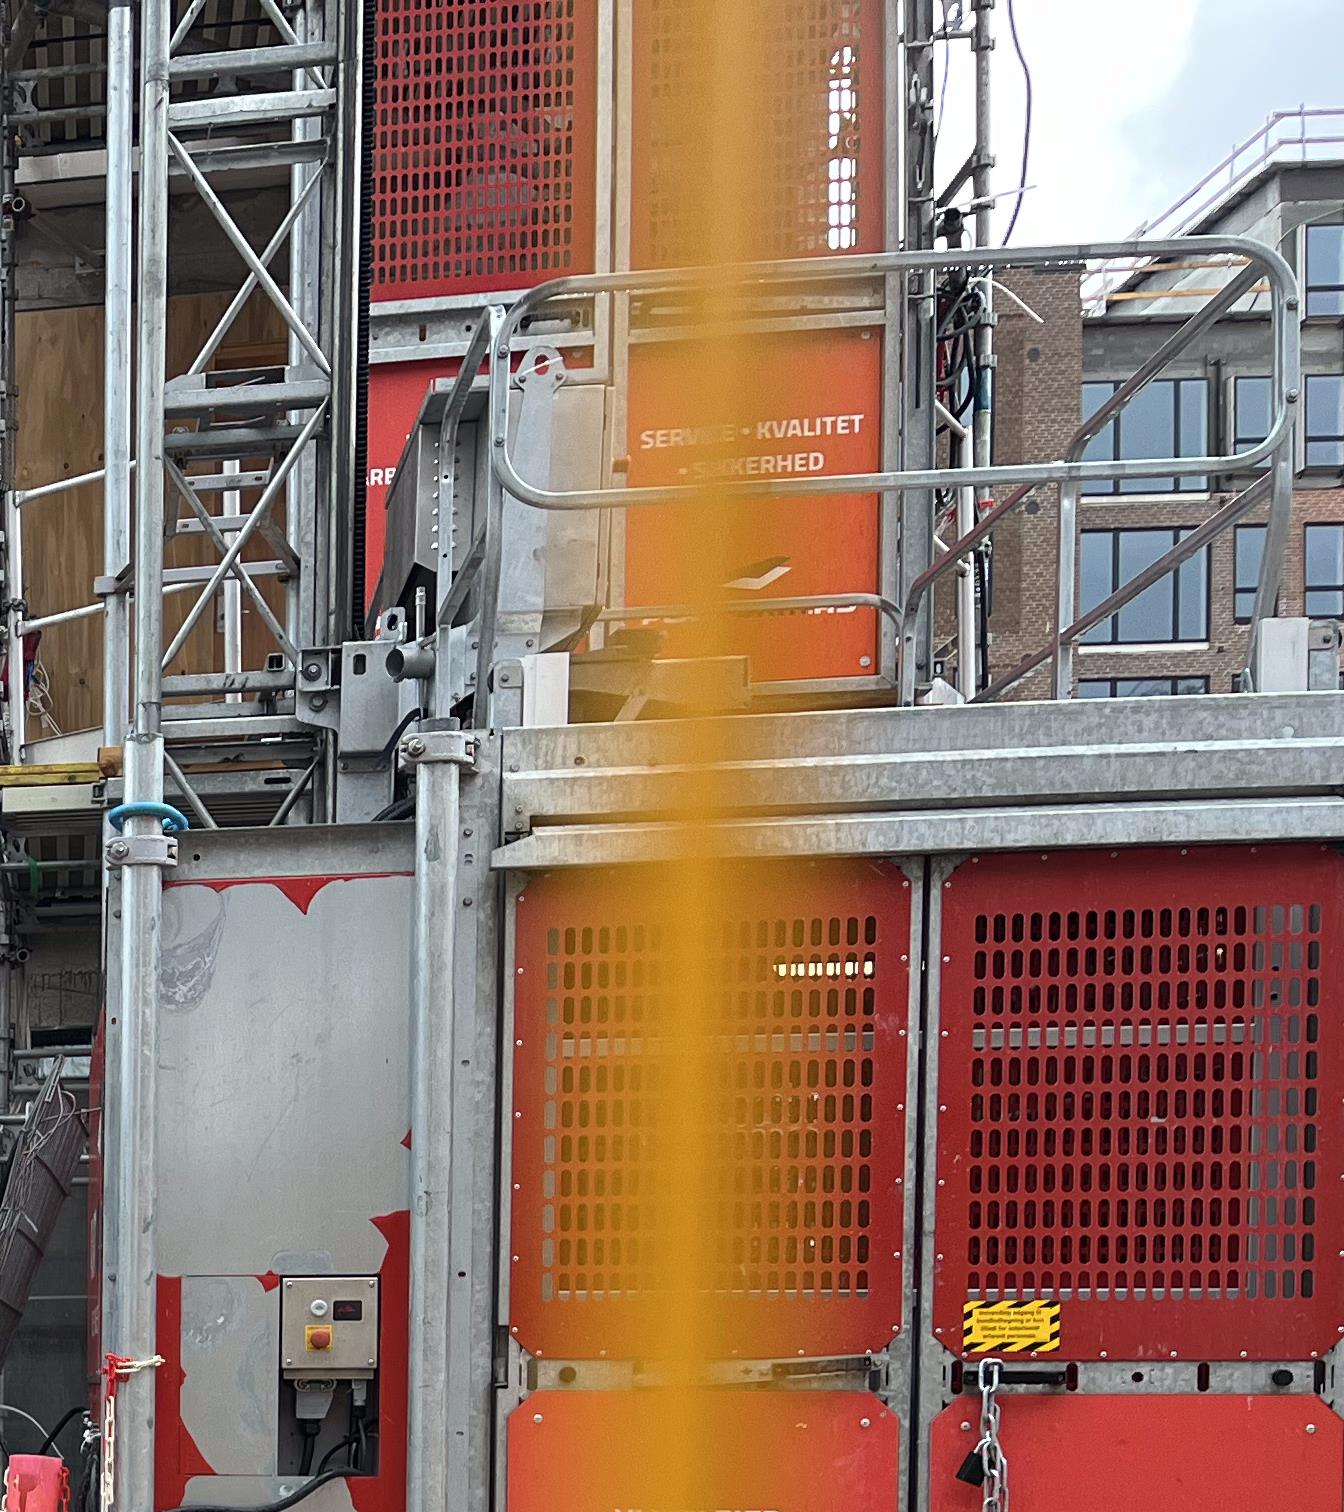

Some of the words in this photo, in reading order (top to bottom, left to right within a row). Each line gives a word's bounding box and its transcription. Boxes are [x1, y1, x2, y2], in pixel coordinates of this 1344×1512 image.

[639, 424, 736, 450] SERVE
[755, 413, 865, 440] KVALITET
[693, 451, 825, 480] SKERHED
